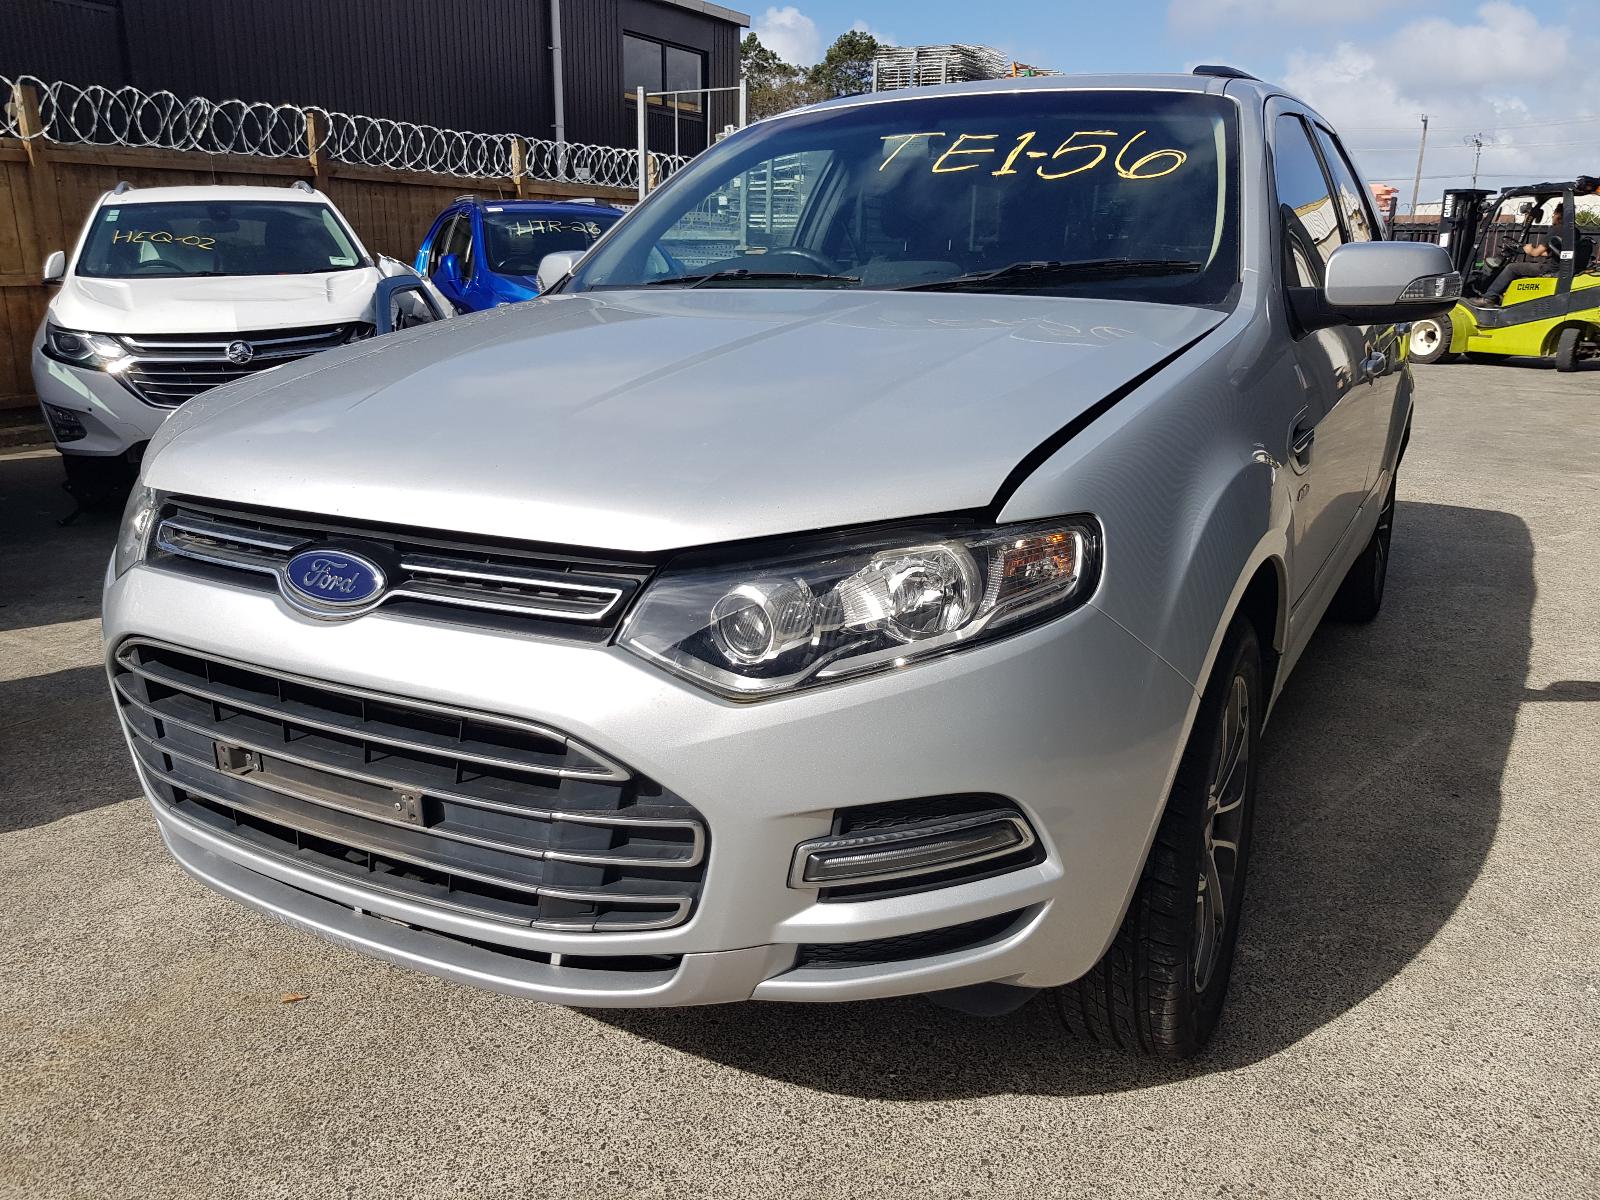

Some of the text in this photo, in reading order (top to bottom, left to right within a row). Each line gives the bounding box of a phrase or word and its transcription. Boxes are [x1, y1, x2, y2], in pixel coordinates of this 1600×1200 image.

[879, 130, 1187, 179] TE1-56
[1443, 194, 1453, 218] CLARK
[113, 230, 216, 250] HEQ-02
[1516, 283, 1540, 291] CLARK
[303, 558, 360, 593] Ford
